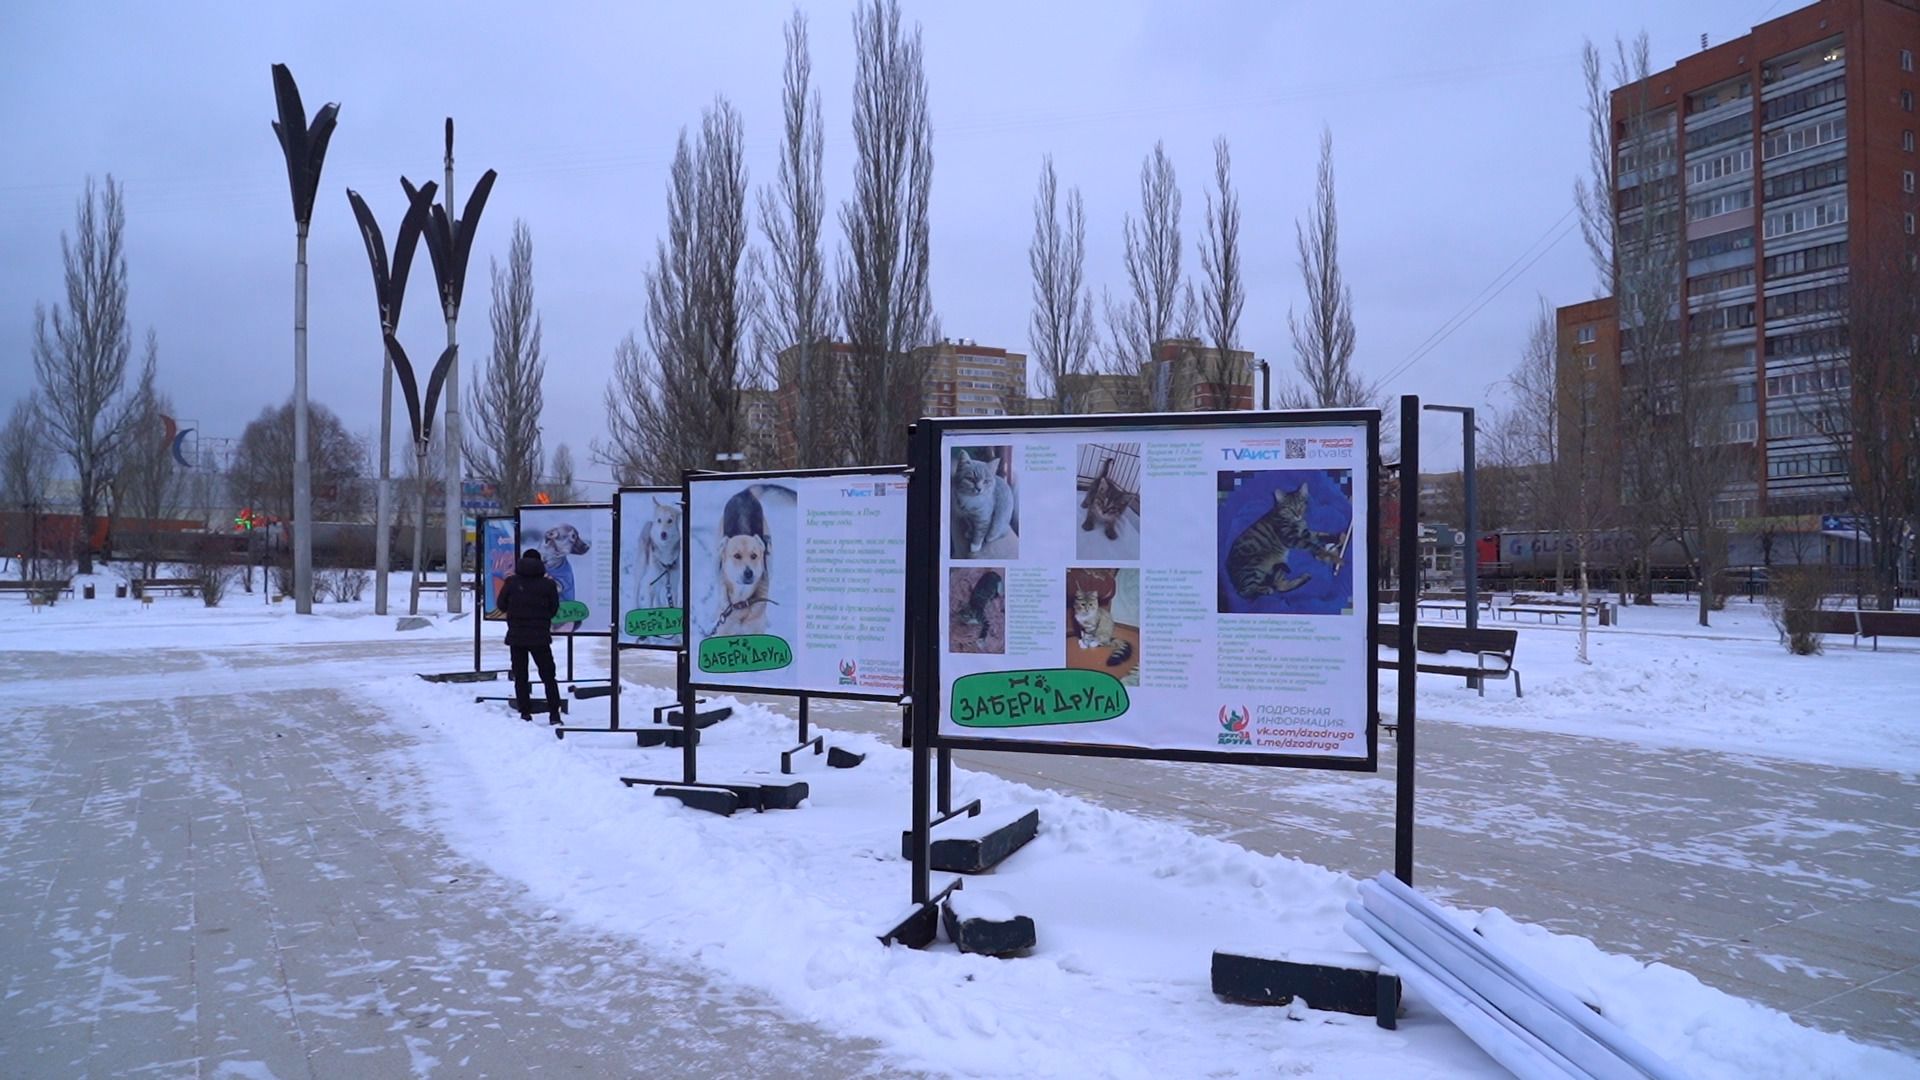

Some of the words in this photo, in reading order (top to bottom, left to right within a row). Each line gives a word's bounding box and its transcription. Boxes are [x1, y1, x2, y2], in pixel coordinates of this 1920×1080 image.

[703, 650, 749, 669] ЗАБЕРИ
[752, 647, 789, 664] ДРУГА!
[960, 691, 1046, 721] ЗАБЕРИ
[1053, 687, 1121, 713] ДРУГА!
[1256, 705, 1331, 716] ПОДРОБНАЯ
[1256, 727, 1355, 741] vk.com/dzadruga
[1256, 738, 1340, 750] t.me/dzadruga
